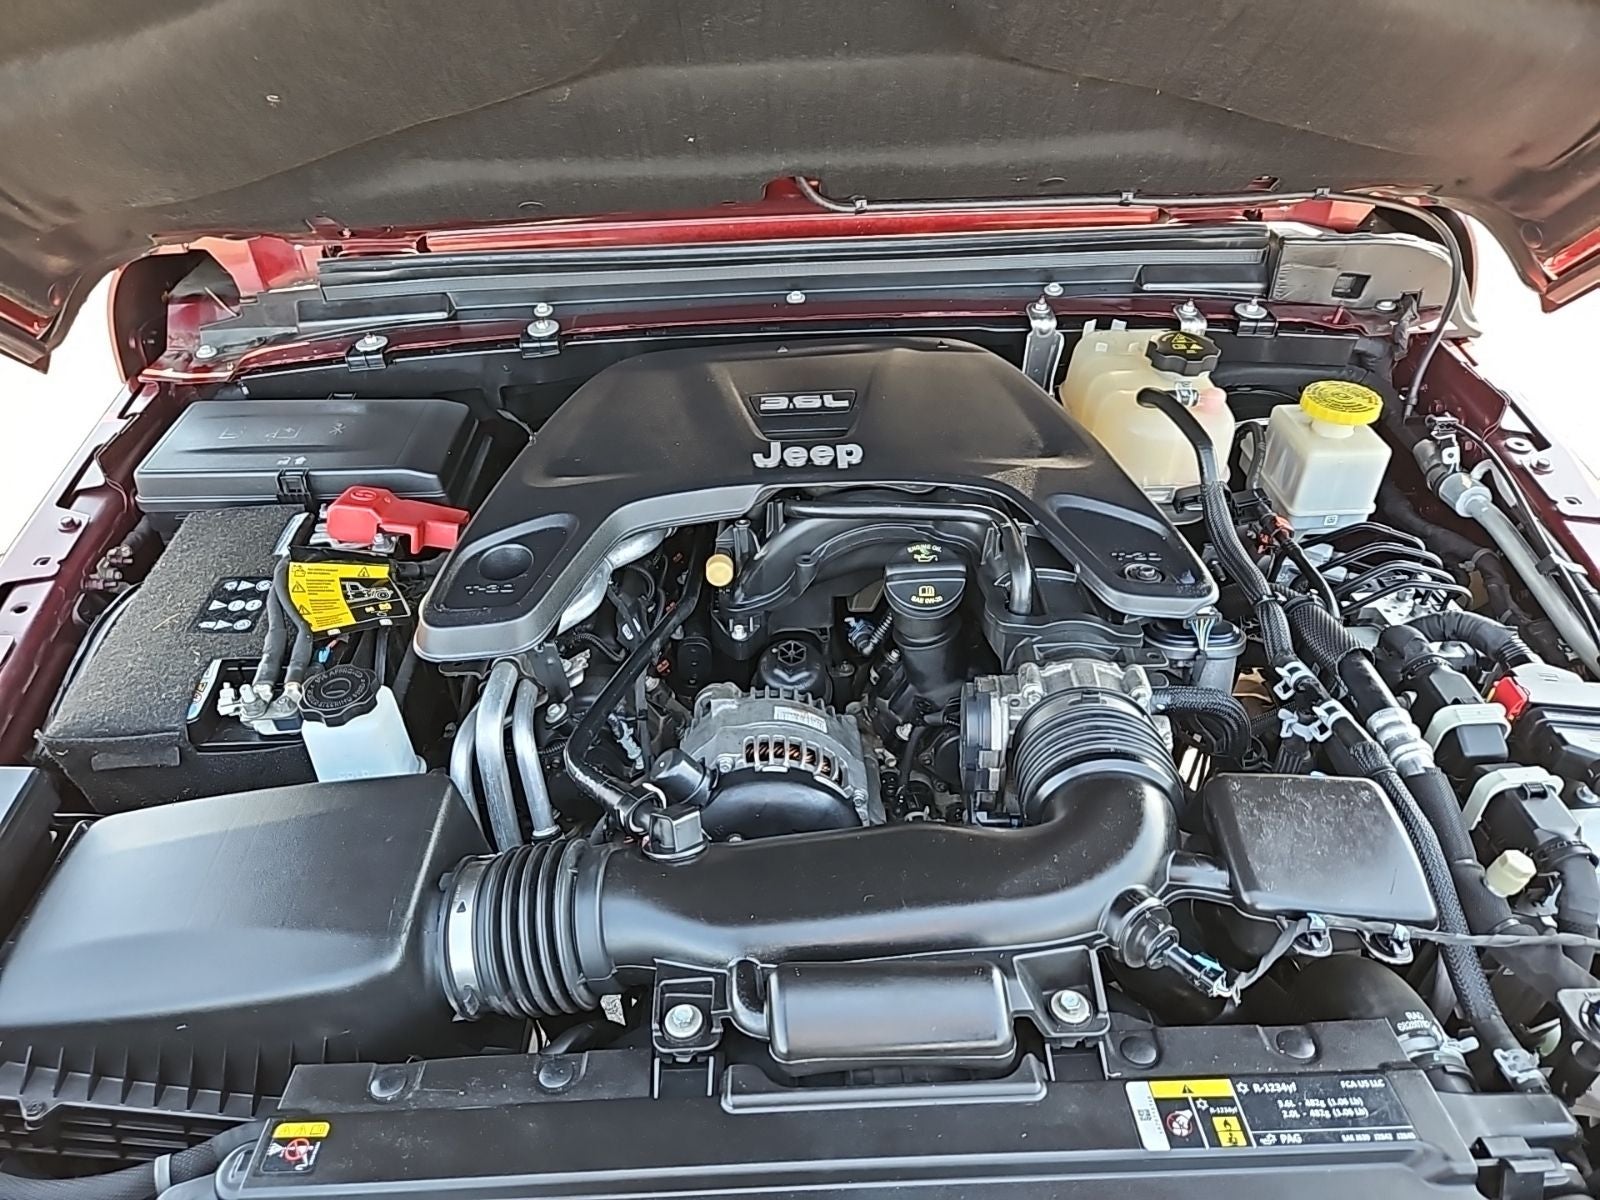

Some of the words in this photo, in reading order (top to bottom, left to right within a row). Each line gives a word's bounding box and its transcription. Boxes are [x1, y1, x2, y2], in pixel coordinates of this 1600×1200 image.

[760, 394, 849, 410] 3.6L
[752, 441, 863, 469] Jeep
[907, 544, 931, 553] ENGINE
[910, 595, 924, 604] SAE
[1252, 1082, 1297, 1094] R-1234yf
[1340, 1080, 1357, 1089] FCA
[1358, 1080, 1369, 1088] US
[1370, 1079, 1385, 1088] LLC
[1282, 1109, 1300, 1119] 2.0L
[1280, 1134, 1302, 1144] PAG
